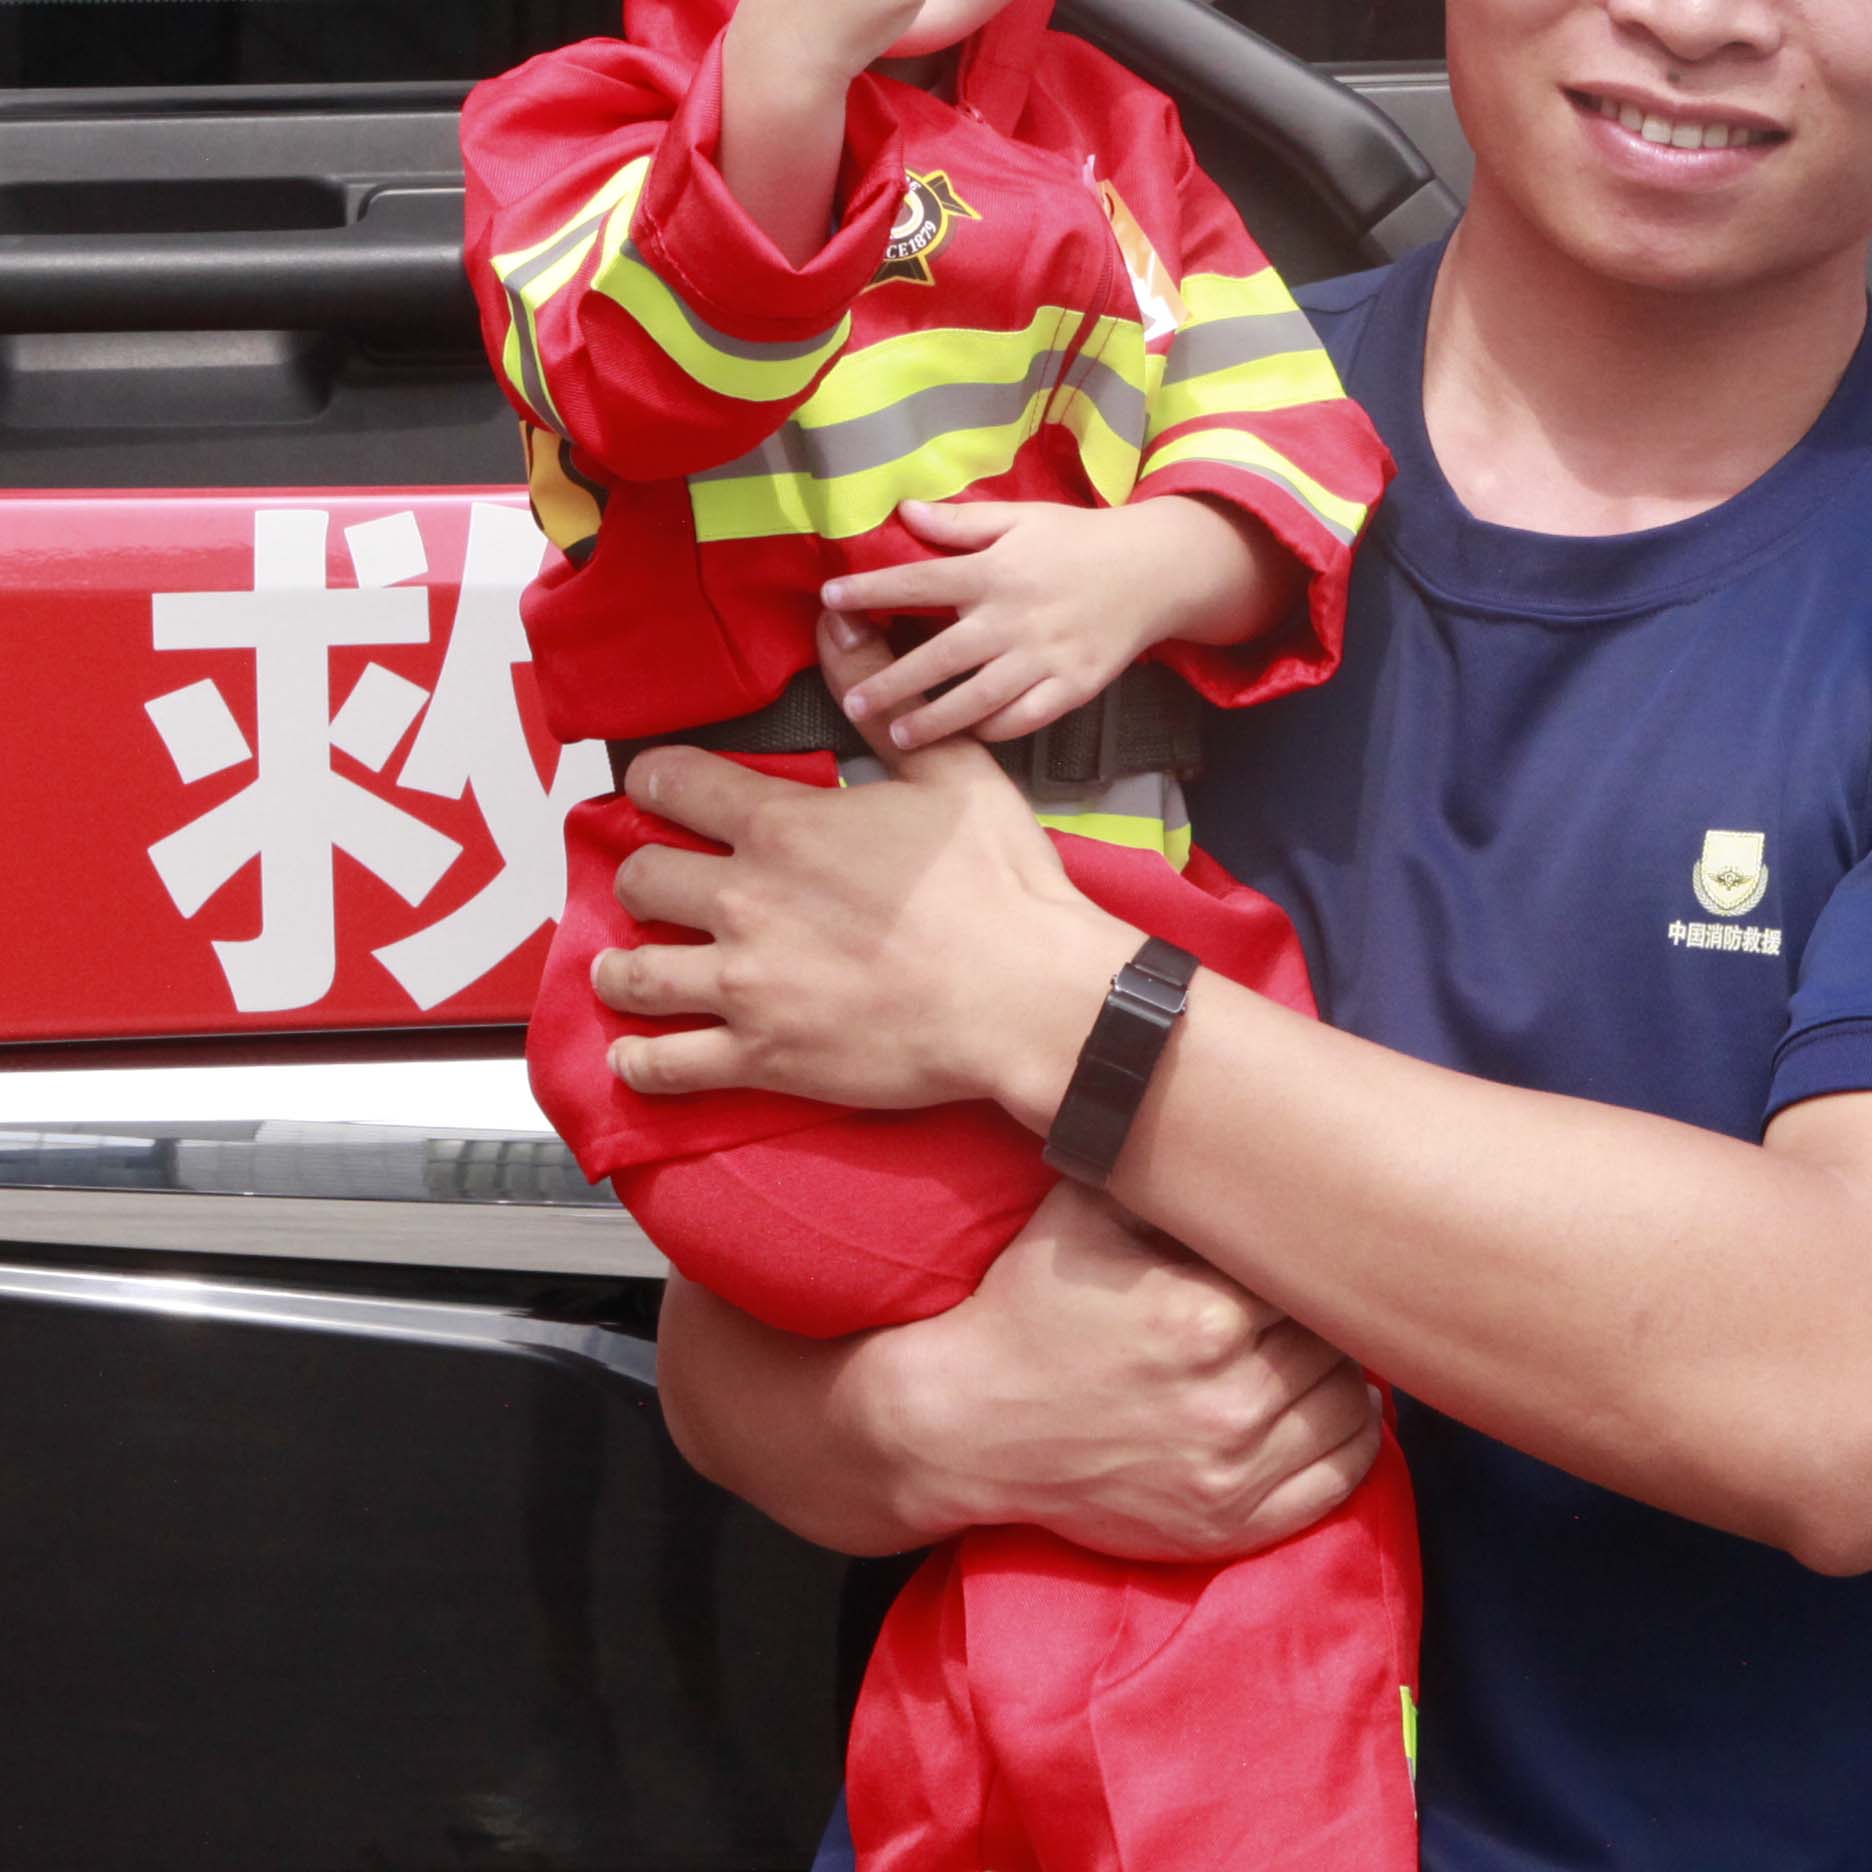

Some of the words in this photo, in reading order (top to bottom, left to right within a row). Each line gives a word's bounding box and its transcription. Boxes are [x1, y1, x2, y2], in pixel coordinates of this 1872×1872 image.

[1668, 920, 1783, 956] 中国消防救援
